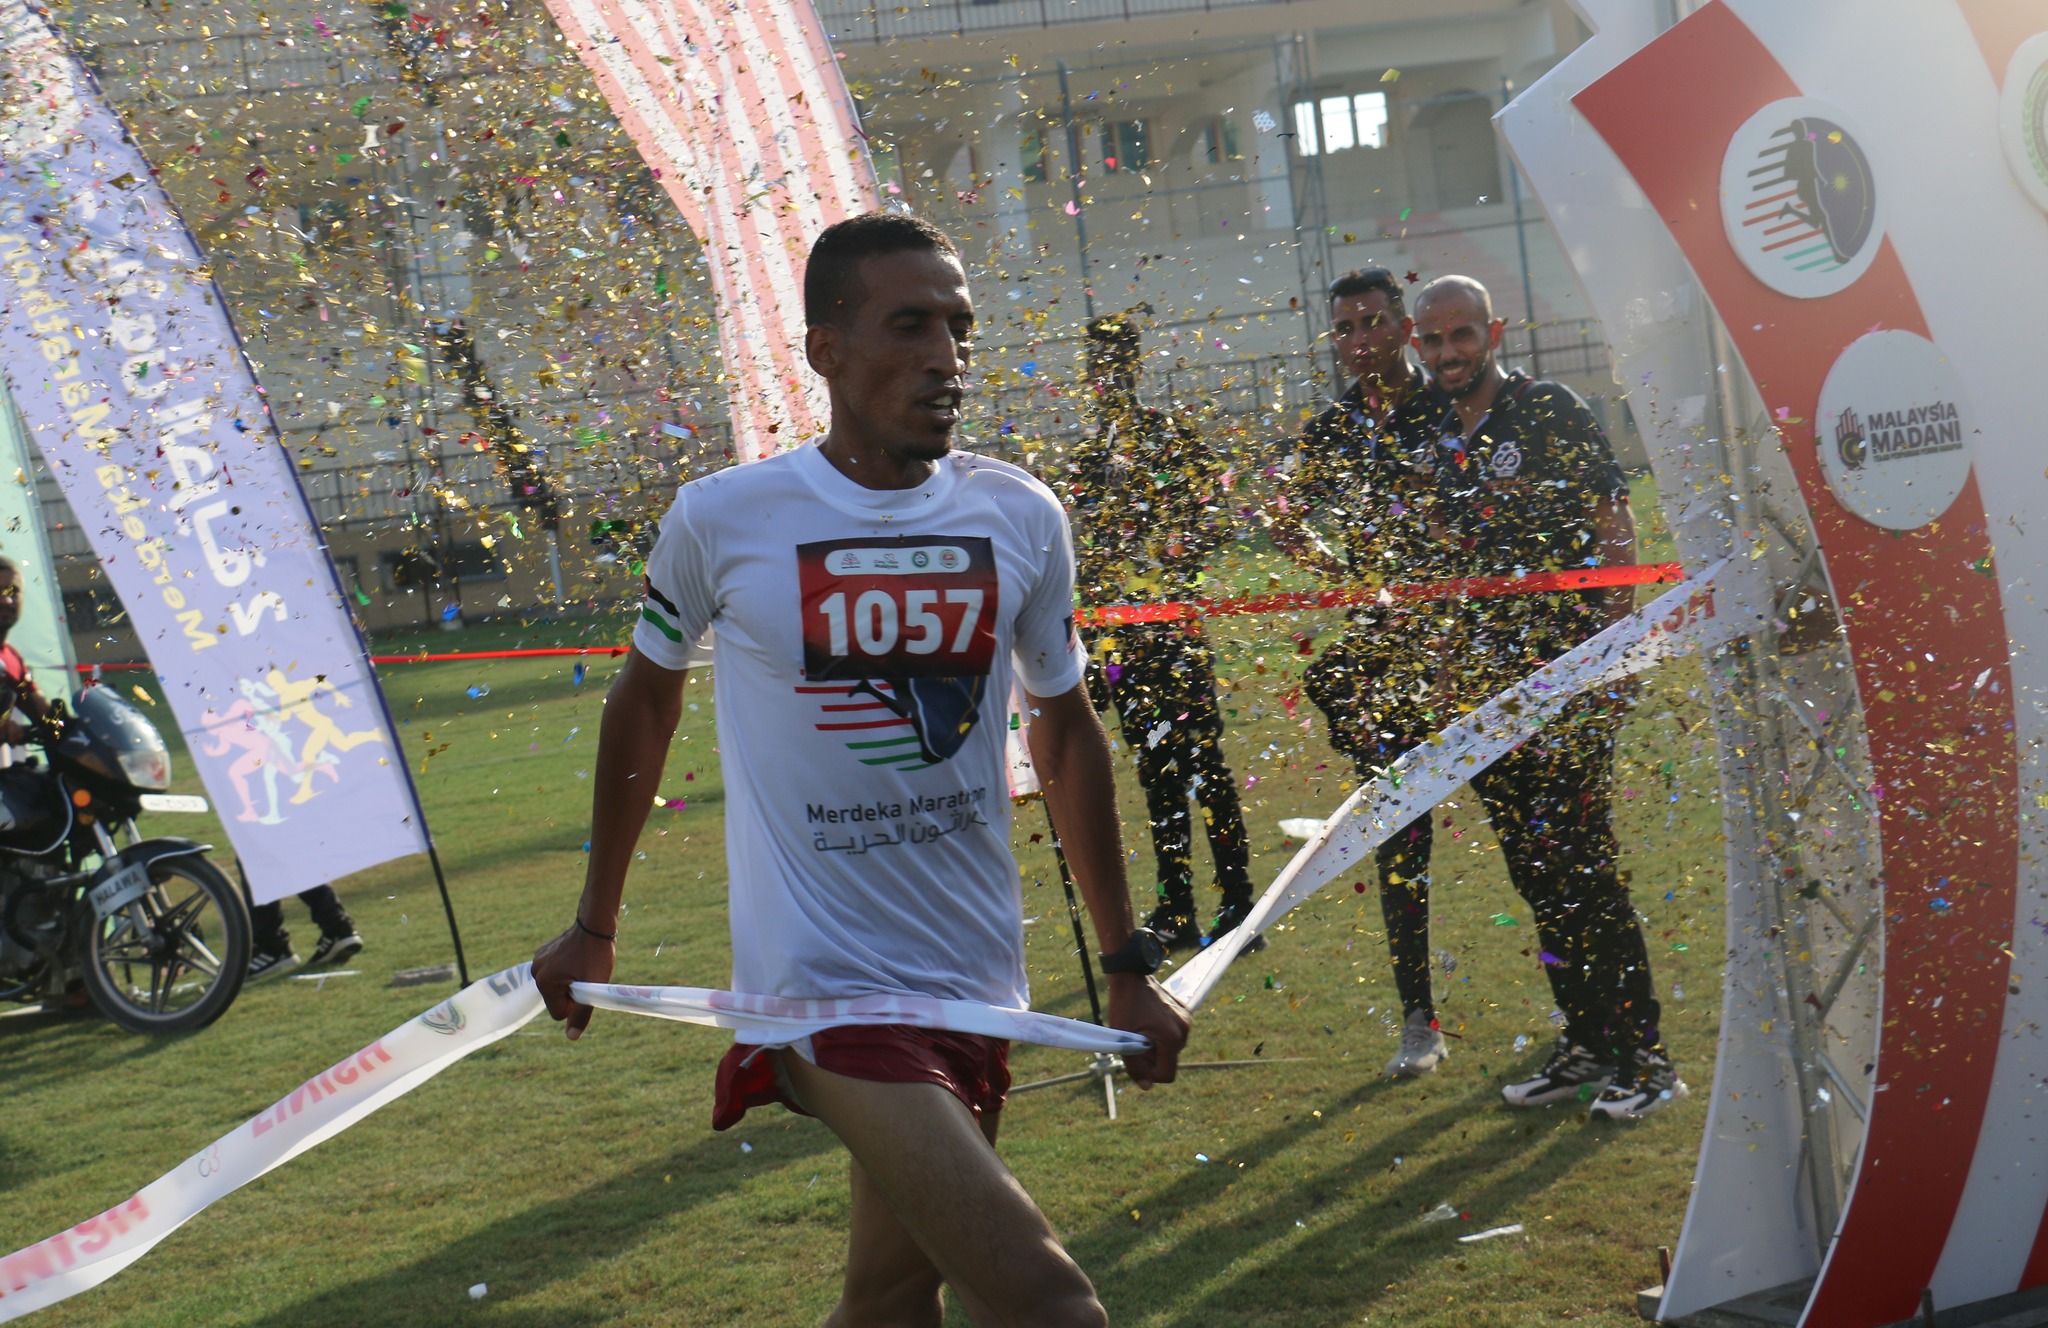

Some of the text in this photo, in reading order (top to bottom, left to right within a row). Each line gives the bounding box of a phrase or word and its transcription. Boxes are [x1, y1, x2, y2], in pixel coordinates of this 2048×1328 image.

[1870, 420, 1962, 455] MADANI
[819, 589, 984, 656] 1057
[806, 787, 986, 823] Merdeka Maratn
[814, 823, 906, 855] الحرية
